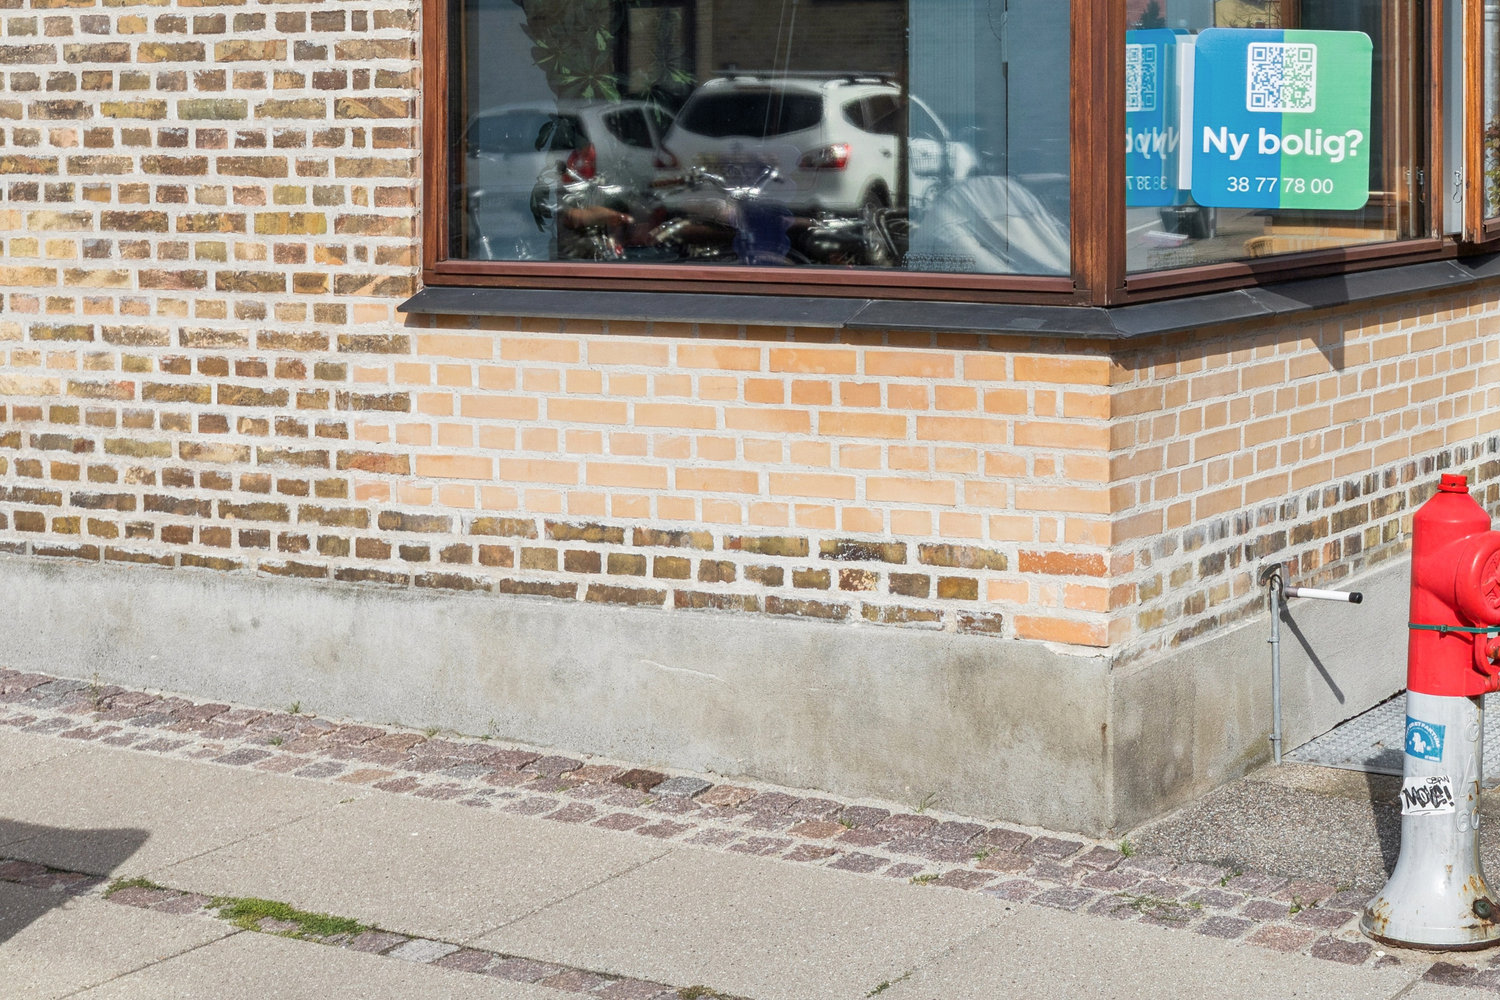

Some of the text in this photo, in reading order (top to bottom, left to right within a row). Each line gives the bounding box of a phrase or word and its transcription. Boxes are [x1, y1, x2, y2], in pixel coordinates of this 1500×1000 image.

[1202, 126, 1364, 163] Ny bolig?
[1226, 176, 1334, 194] 38 77 78 00
